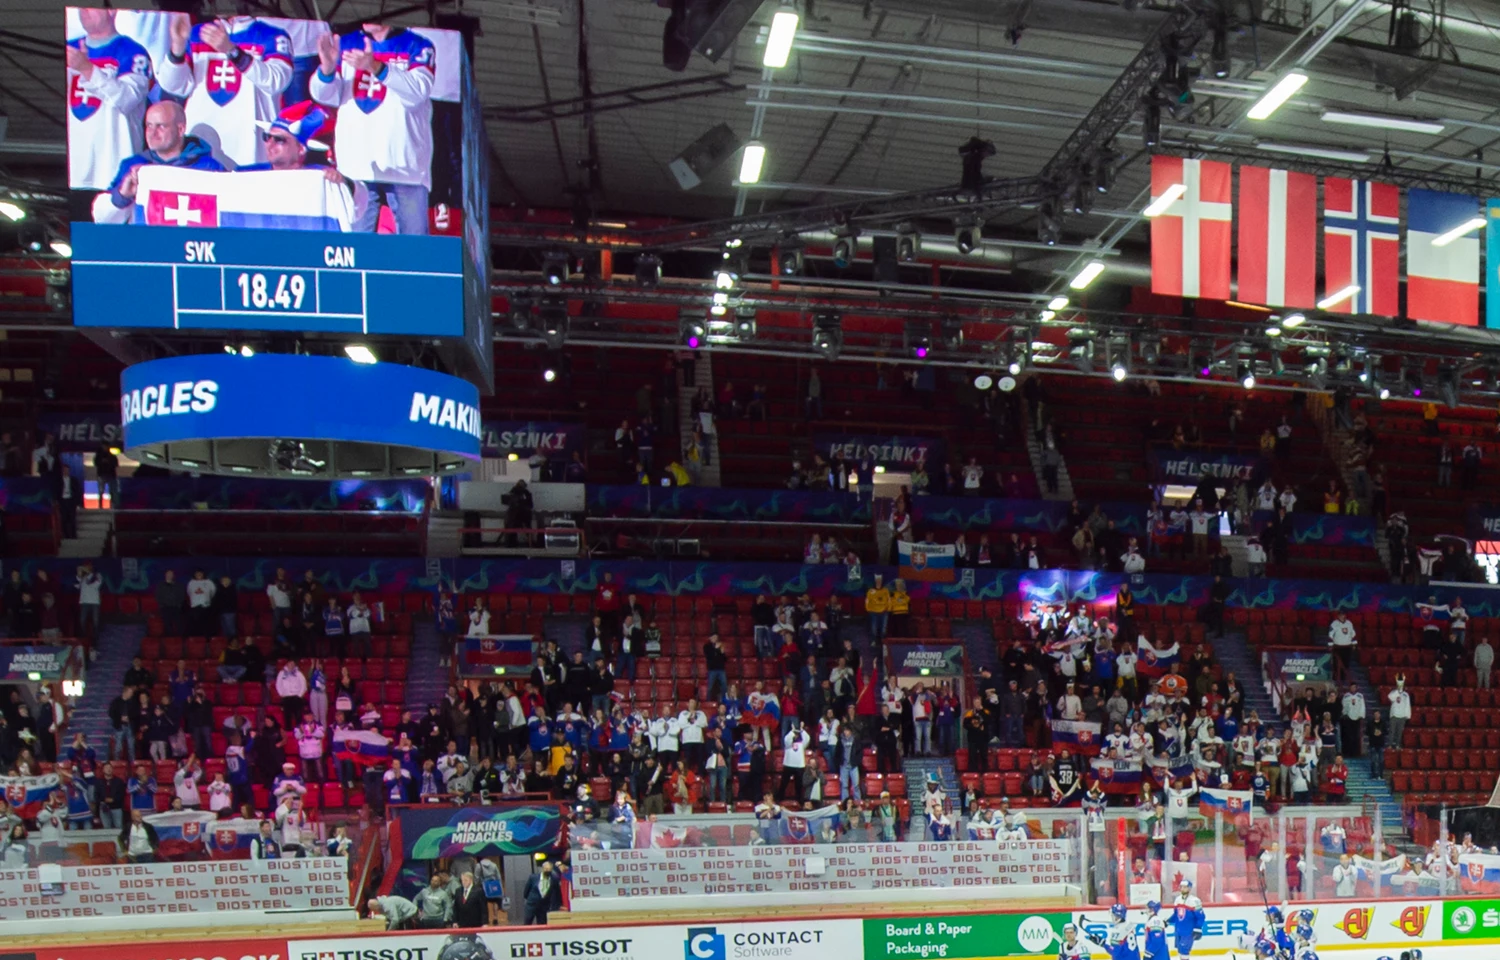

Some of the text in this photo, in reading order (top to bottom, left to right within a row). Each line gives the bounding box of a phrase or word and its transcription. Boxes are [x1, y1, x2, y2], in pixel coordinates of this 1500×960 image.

[185, 241, 355, 268] SVK CAN
[237, 273, 306, 309] 18.49
[829, 443, 928, 461] HELSINKI
[13, 653, 55, 662] MAKING
[903, 659, 946, 668] MIRACLES
[906, 651, 942, 660] MAKING
[9, 662, 59, 671] MIRACLES
[1058, 770, 1074, 785] 38
[456, 820, 508, 833] MAKING
[451, 831, 513, 844] MIRACLES
[578, 851, 648, 861] BIOSTEEL
[666, 849, 735, 858] BIOSTEEL
[752, 846, 820, 856] BIOSTEEL
[836, 845, 902, 854] BIOSTEEL
[918, 843, 982, 852] BIOSTEEL
[77, 866, 154, 877] BIOSTEEL
[173, 862, 249, 873] BIOSTEEL
[268, 859, 342, 870] BIOSTEEL
[616, 862, 686, 872] BIOSTEEL
[703, 860, 772, 869] BIOSTEEL
[872, 856, 937, 865] BIOSTEEL
[953, 853, 1017, 863] BIOSTEEL
[120, 878, 196, 889] BIOSTEEL
[214, 874, 290, 885] BIOSTEEL
[579, 875, 650, 885] BIOSTEEL
[667, 872, 736, 883] BIOSTEEL
[837, 868, 902, 877] BIOSTEEL
[918, 866, 983, 875] BIOSTEEL
[999, 864, 1061, 873] BIOSTEEL
[789, 881, 856, 891] BIOSTEEL
[953, 877, 1017, 886] BIOSTEEL
[79, 892, 156, 904] BIOSTEEL
[175, 888, 251, 900] BIOSTEEL
[269, 885, 344, 895] BIOSTEEL
[26, 907, 103, 919] BIOSTEEL
[122, 903, 198, 914] BIOSTEEL
[216, 899, 292, 910] BIOSTEEL
[733, 930, 824, 948] CONTACT
[886, 923, 972, 939] Board & Paper
[1021, 928, 1051, 941] MM
[545, 938, 633, 957] TISSOT
[733, 945, 793, 960] Software
[886, 941, 949, 959] Packaging
